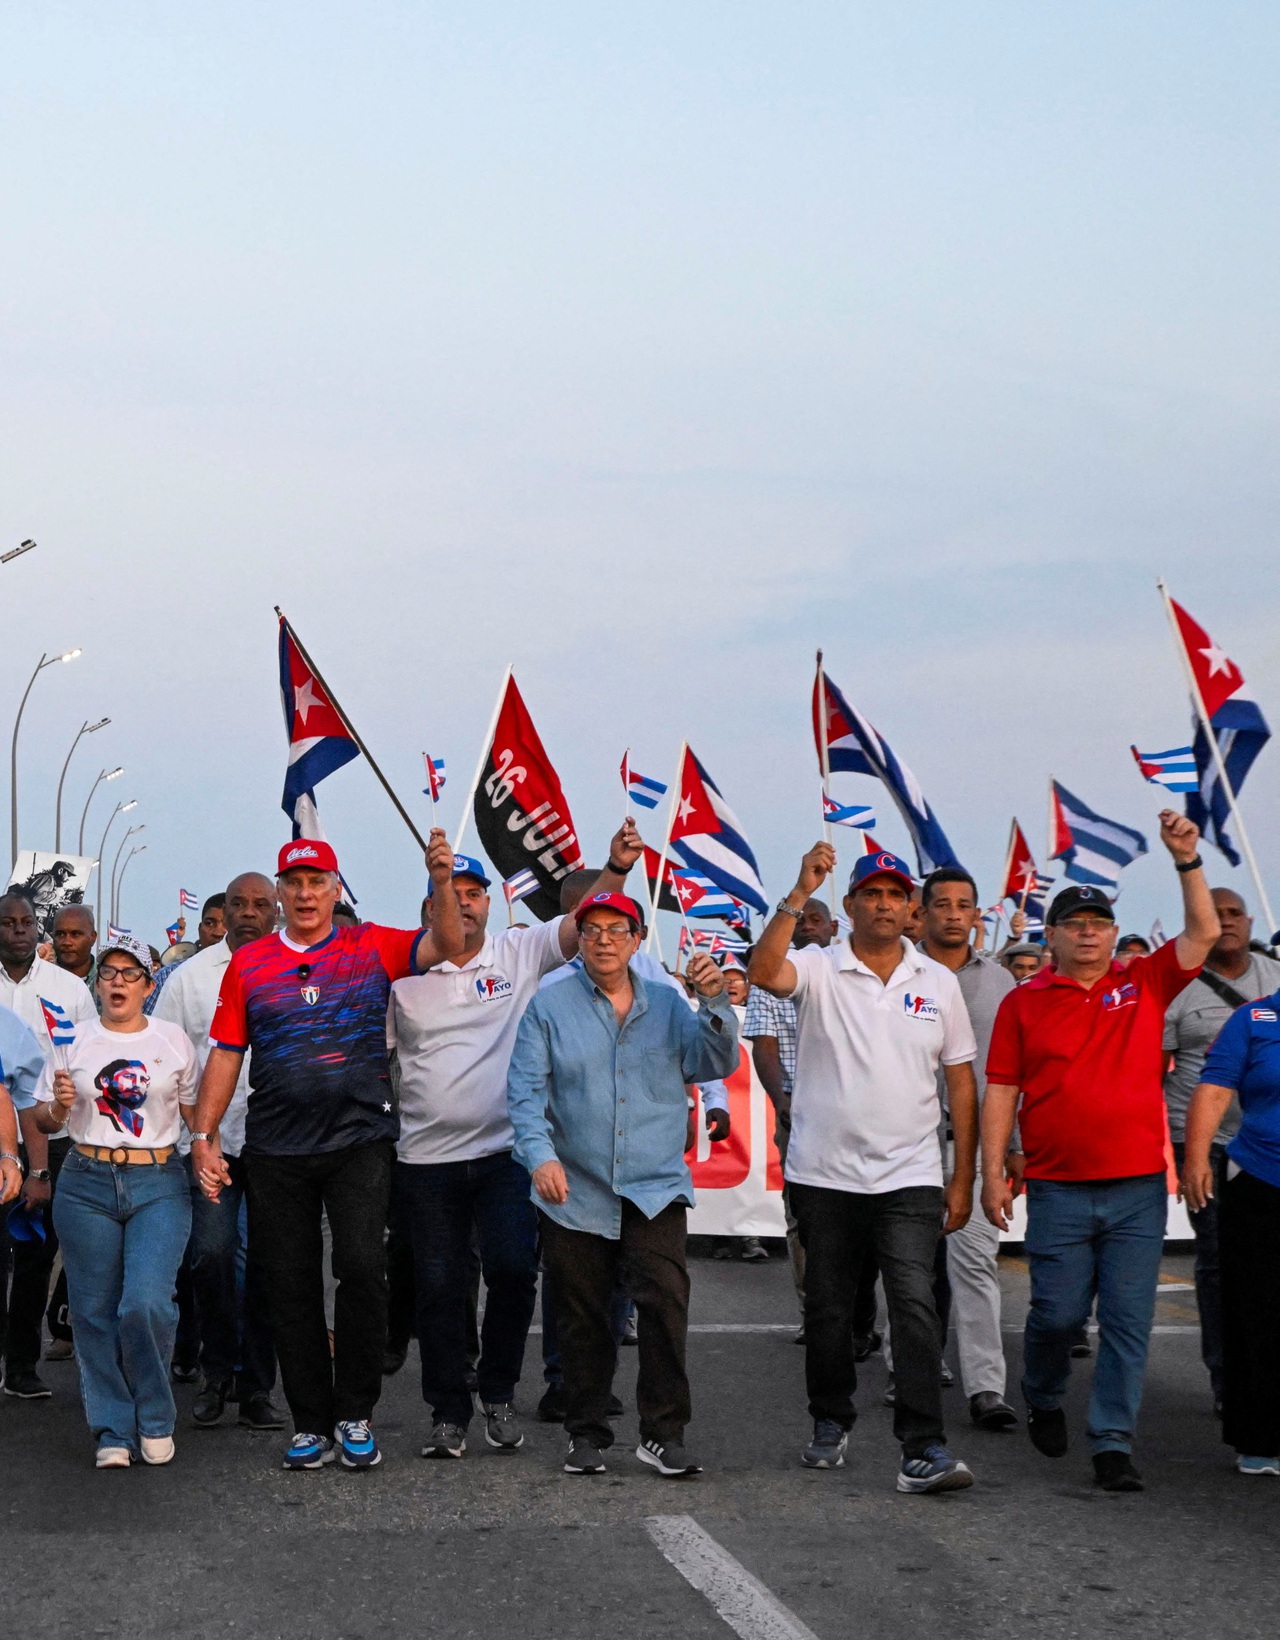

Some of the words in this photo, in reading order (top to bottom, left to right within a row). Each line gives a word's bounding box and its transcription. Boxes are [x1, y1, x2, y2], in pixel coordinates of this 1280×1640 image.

[484, 748, 527, 808] 26
[507, 801, 587, 881] JULI
[876, 853, 896, 870] C
